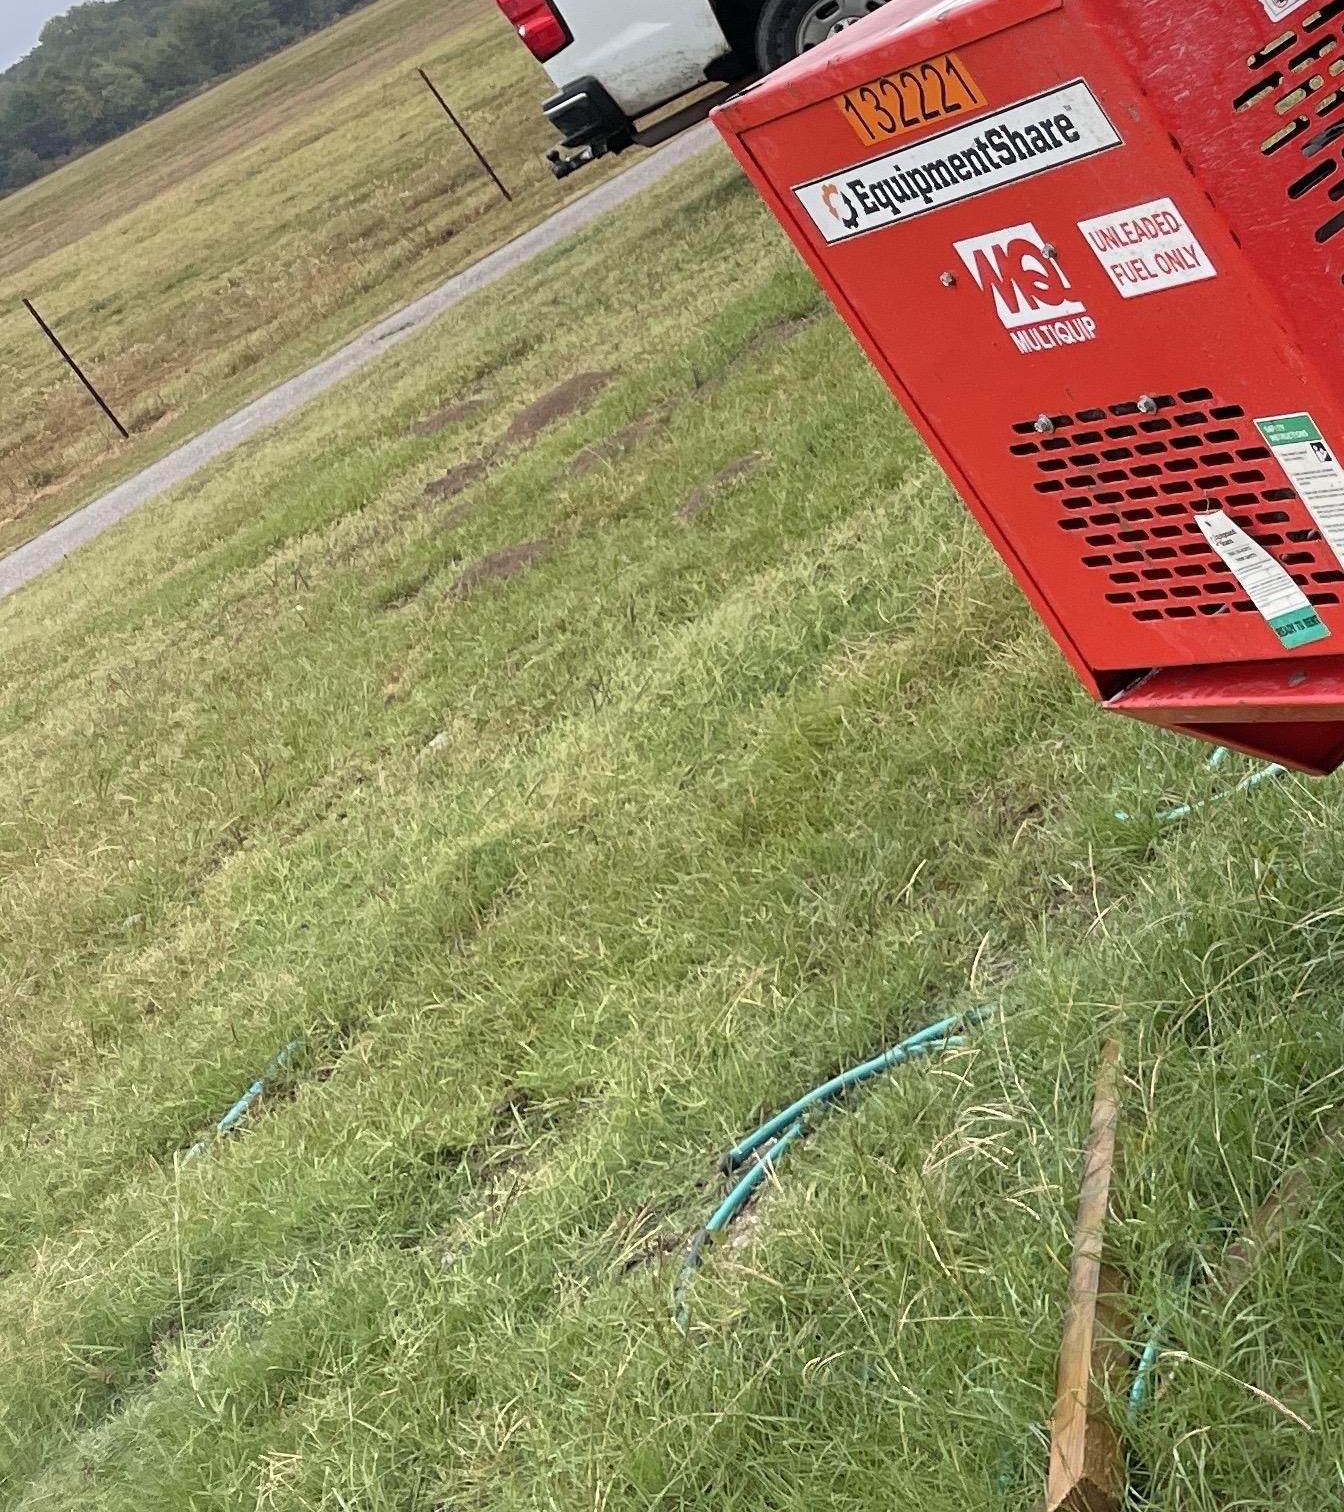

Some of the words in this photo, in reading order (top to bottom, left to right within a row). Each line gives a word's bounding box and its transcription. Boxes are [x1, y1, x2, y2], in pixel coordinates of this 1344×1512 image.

[843, 56, 978, 140] 132221
[846, 111, 1081, 215] EquipmentShare
[1088, 210, 1181, 253] UNLEADED
[972, 237, 1076, 315] MQ
[1109, 256, 1159, 286] FUEL
[1154, 244, 1201, 275] ONLY
[1010, 316, 1097, 355] MULTIQUIP
